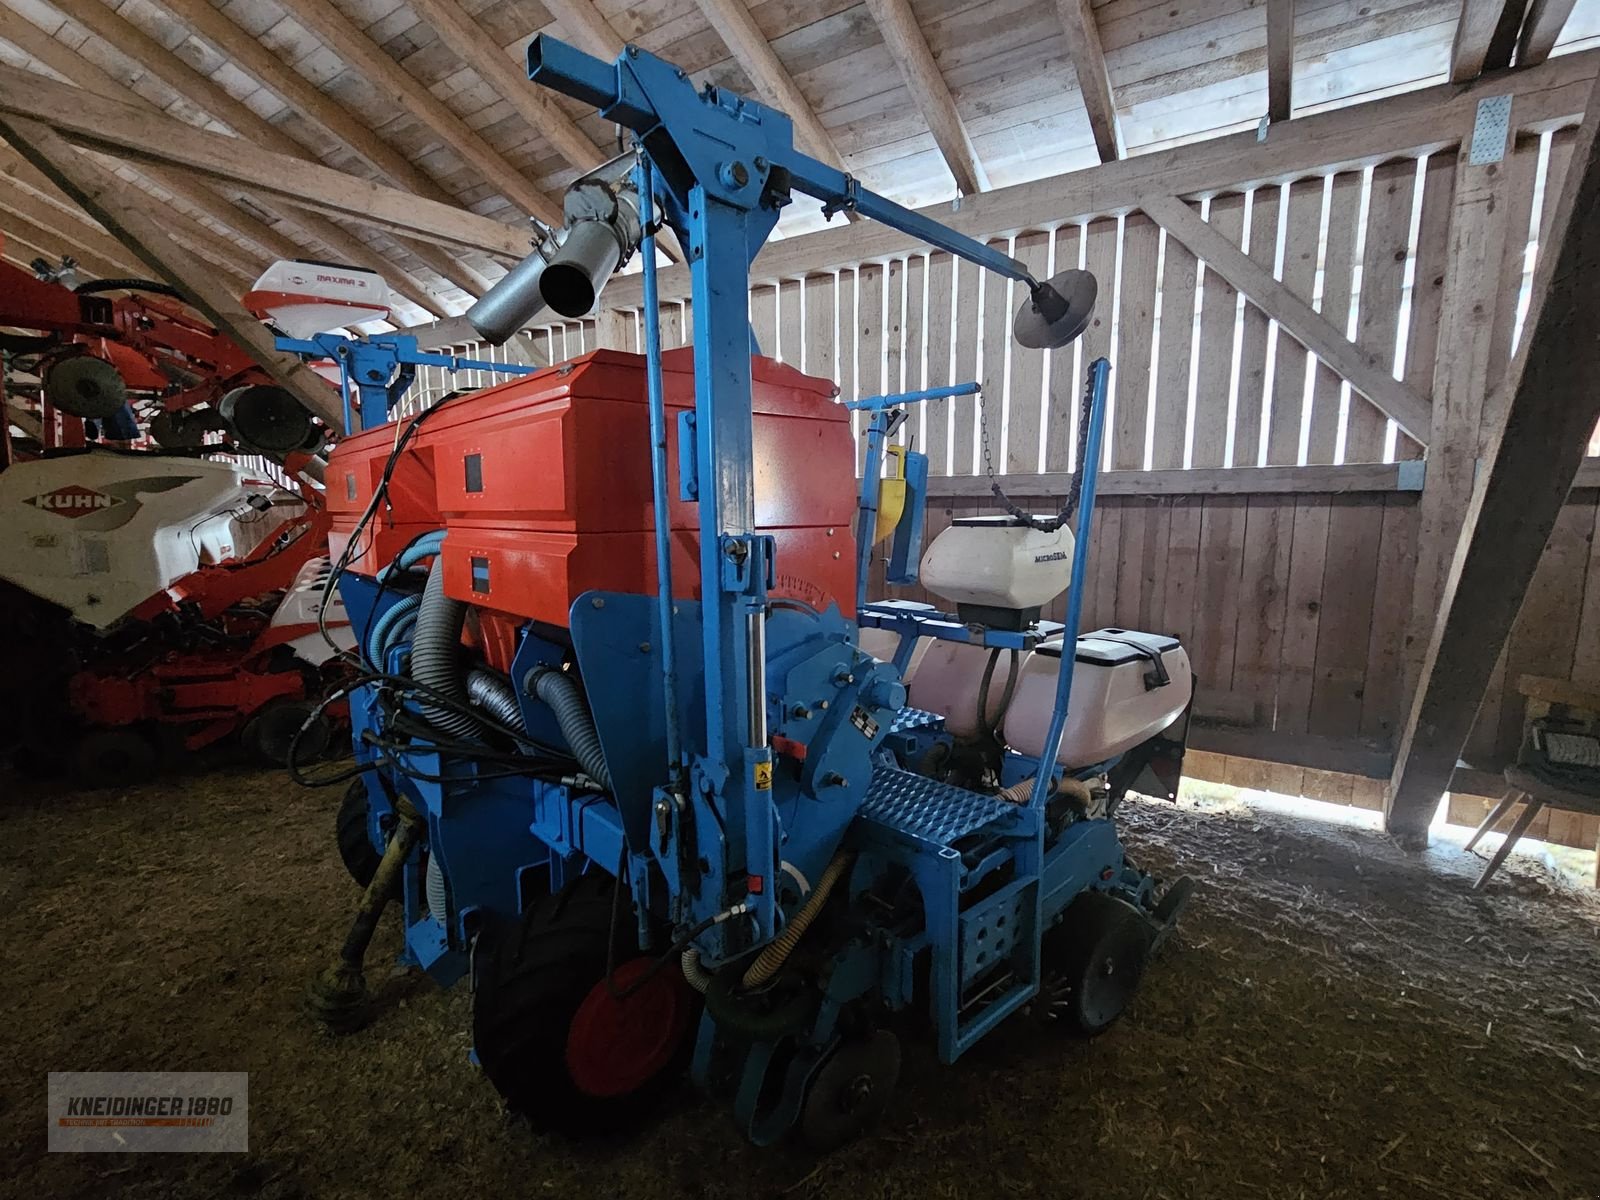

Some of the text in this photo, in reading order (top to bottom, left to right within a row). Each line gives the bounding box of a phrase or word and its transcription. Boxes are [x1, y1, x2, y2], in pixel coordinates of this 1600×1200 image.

[316, 274, 356, 287] MAXIMA
[35, 493, 111, 509] KUHN
[1034, 551, 1068, 563] MICROSEM
